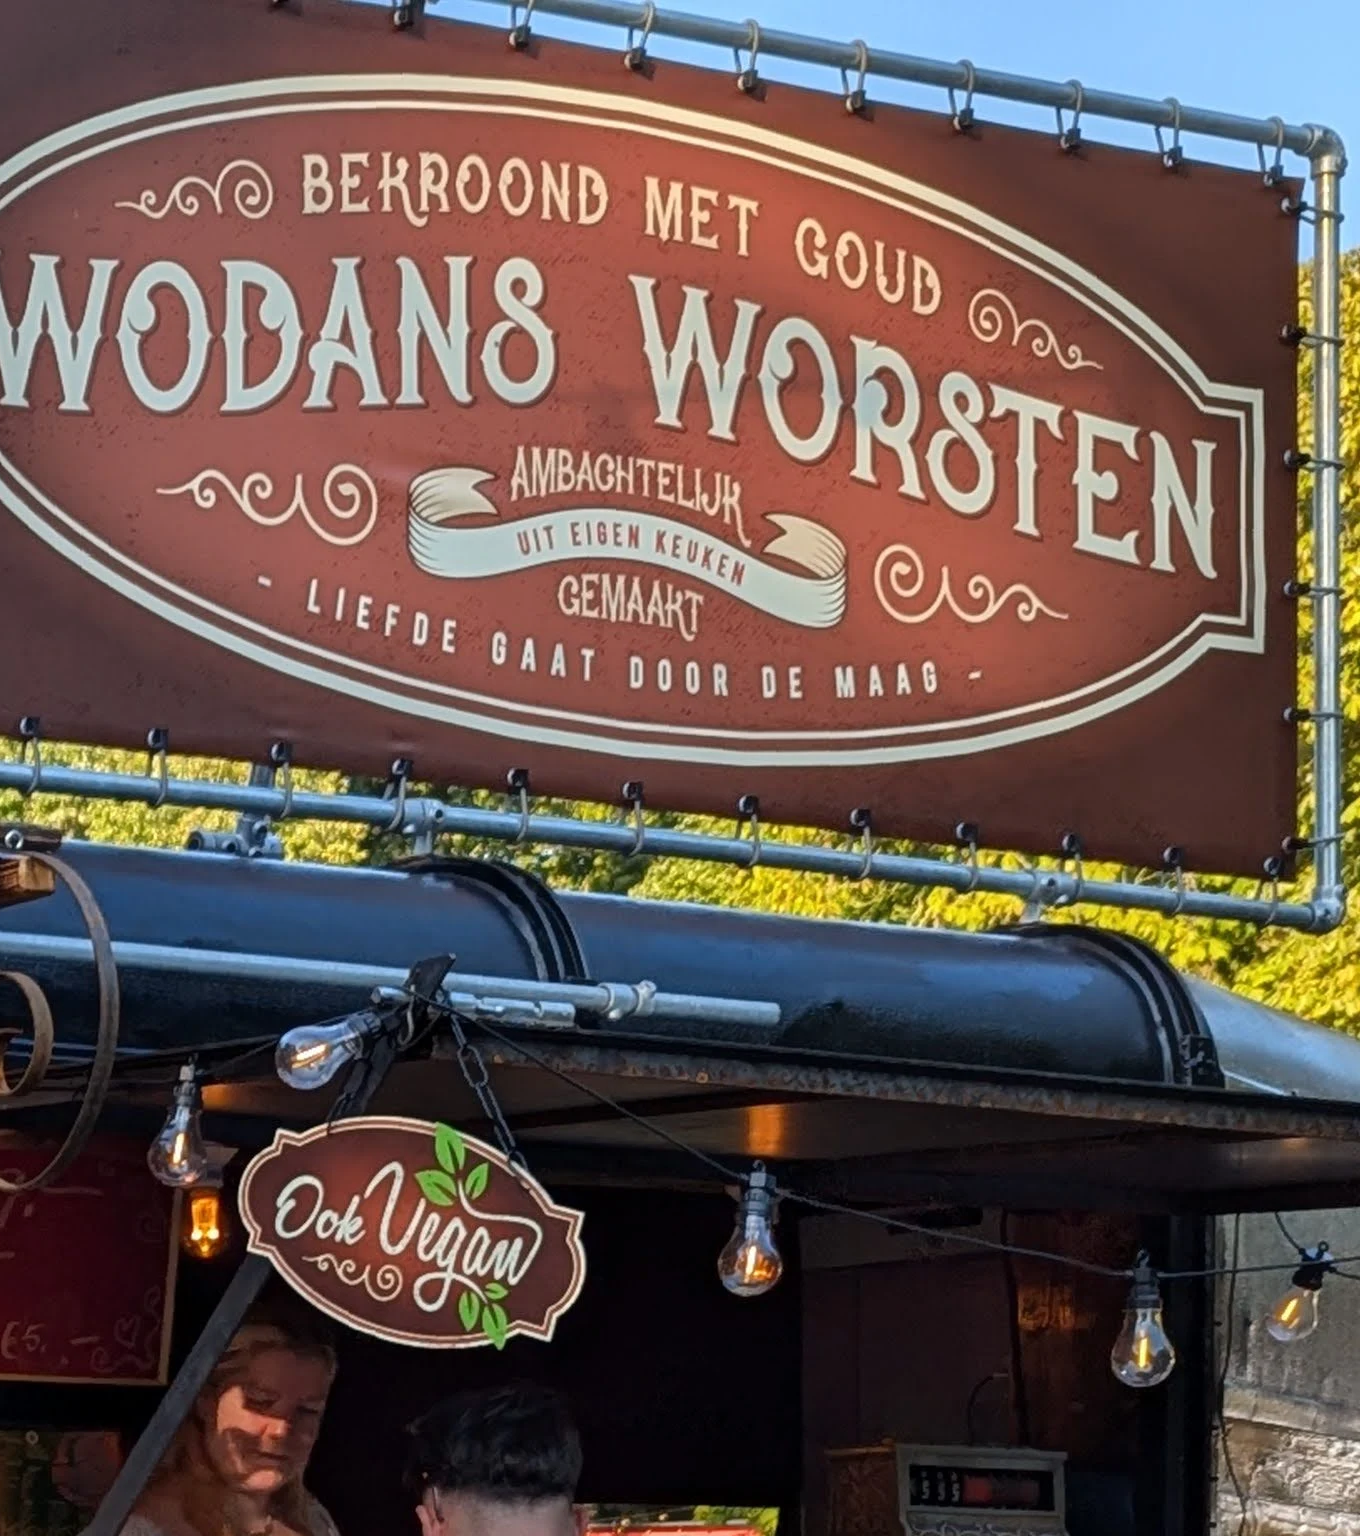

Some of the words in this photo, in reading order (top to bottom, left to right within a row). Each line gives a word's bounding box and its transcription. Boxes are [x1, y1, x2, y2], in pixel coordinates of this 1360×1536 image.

[302, 151, 608, 228] BEKROOND
[644, 175, 759, 257] MET
[794, 217, 942, 315] GOUD
[628, 274, 1218, 580] WORSTEN
[510, 446, 752, 548] AMBACHTELIJK
[516, 524, 555, 556] UIT
[570, 519, 640, 549] EIGEN
[655, 528, 746, 586] KEUKEN
[306, 578, 457, 653] LIEFDE
[491, 631, 596, 681] GAAT
[628, 655, 729, 697] DOOR
[761, 665, 803, 699] DE
[834, 660, 938, 698] MAAG
[557, 573, 704, 642] GEMAAKT
[275, 1174, 366, 1246] Ook
[363, 1161, 543, 1313] Vegan
